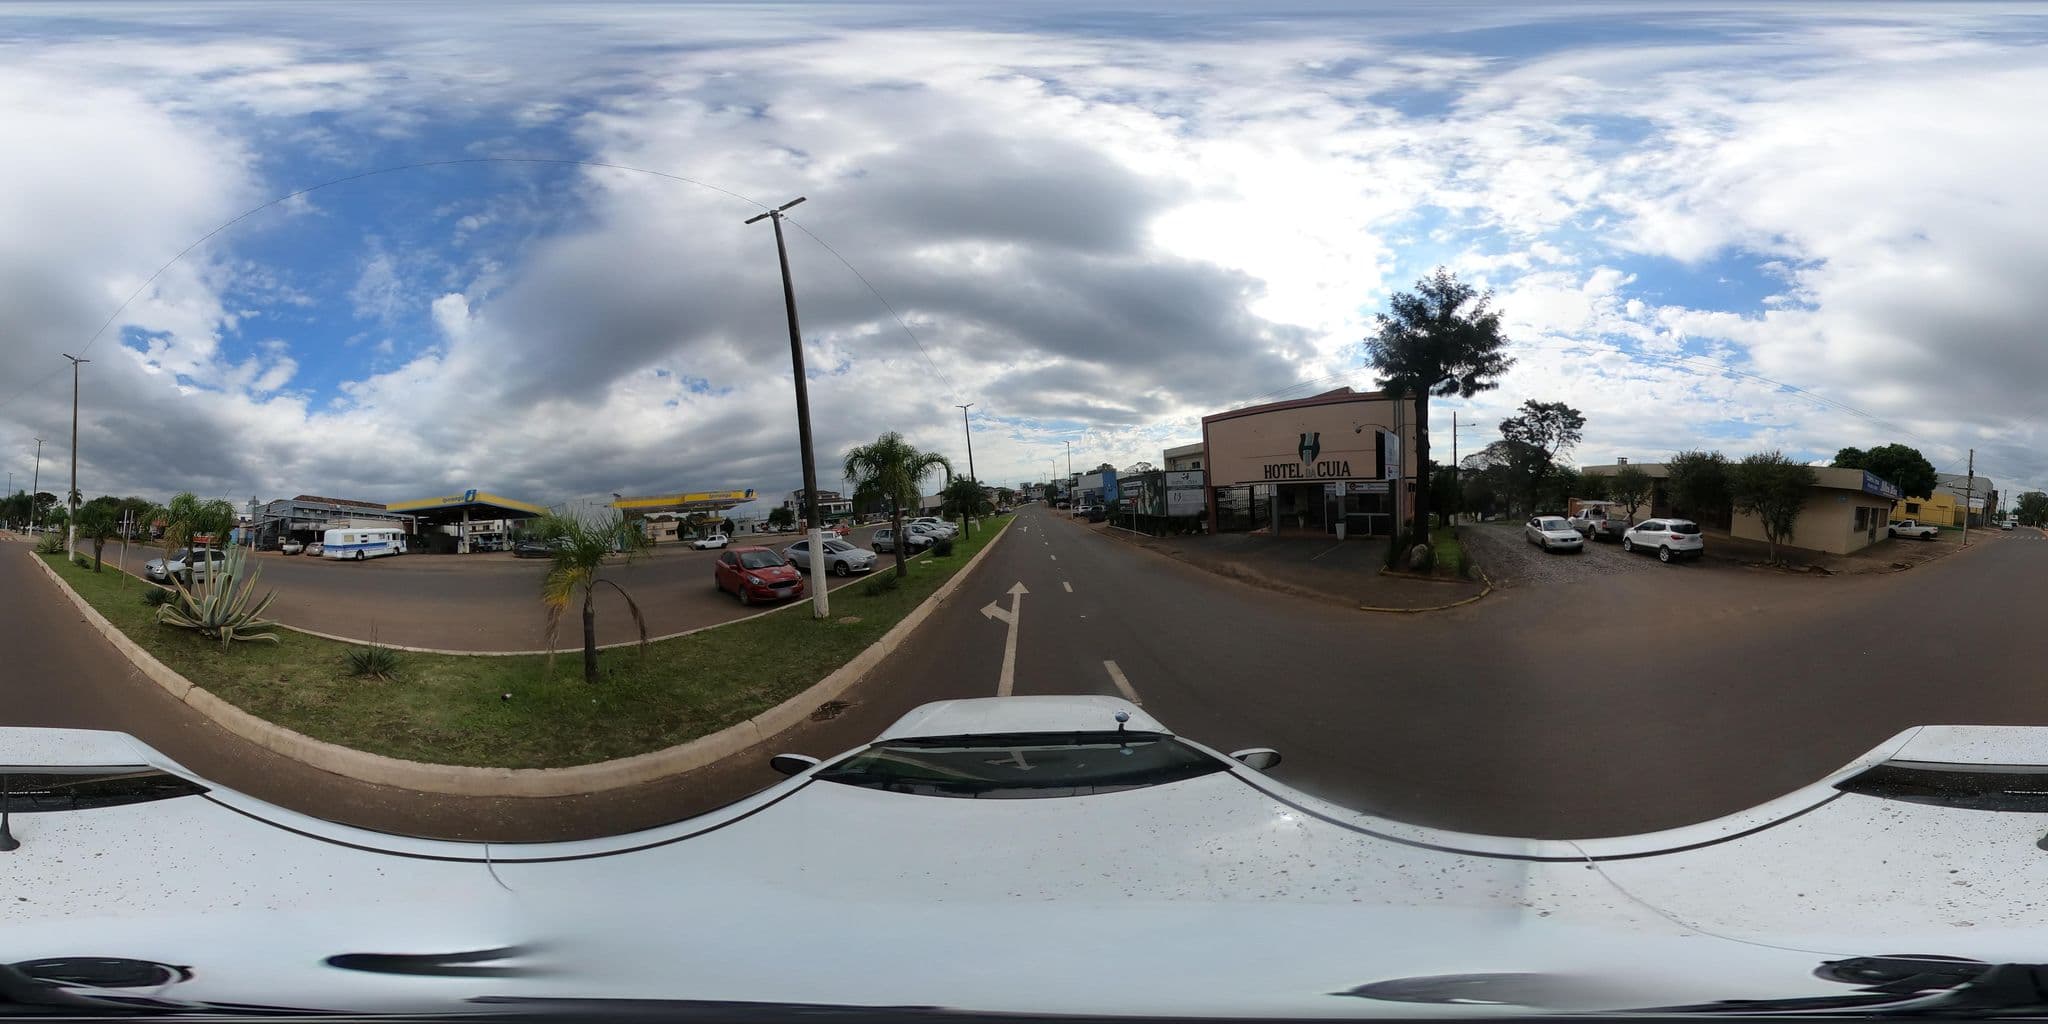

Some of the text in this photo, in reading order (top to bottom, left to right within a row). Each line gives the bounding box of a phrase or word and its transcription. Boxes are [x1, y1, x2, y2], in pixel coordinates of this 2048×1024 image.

[1264, 461, 1351, 479] HOTEL DA CUIA
